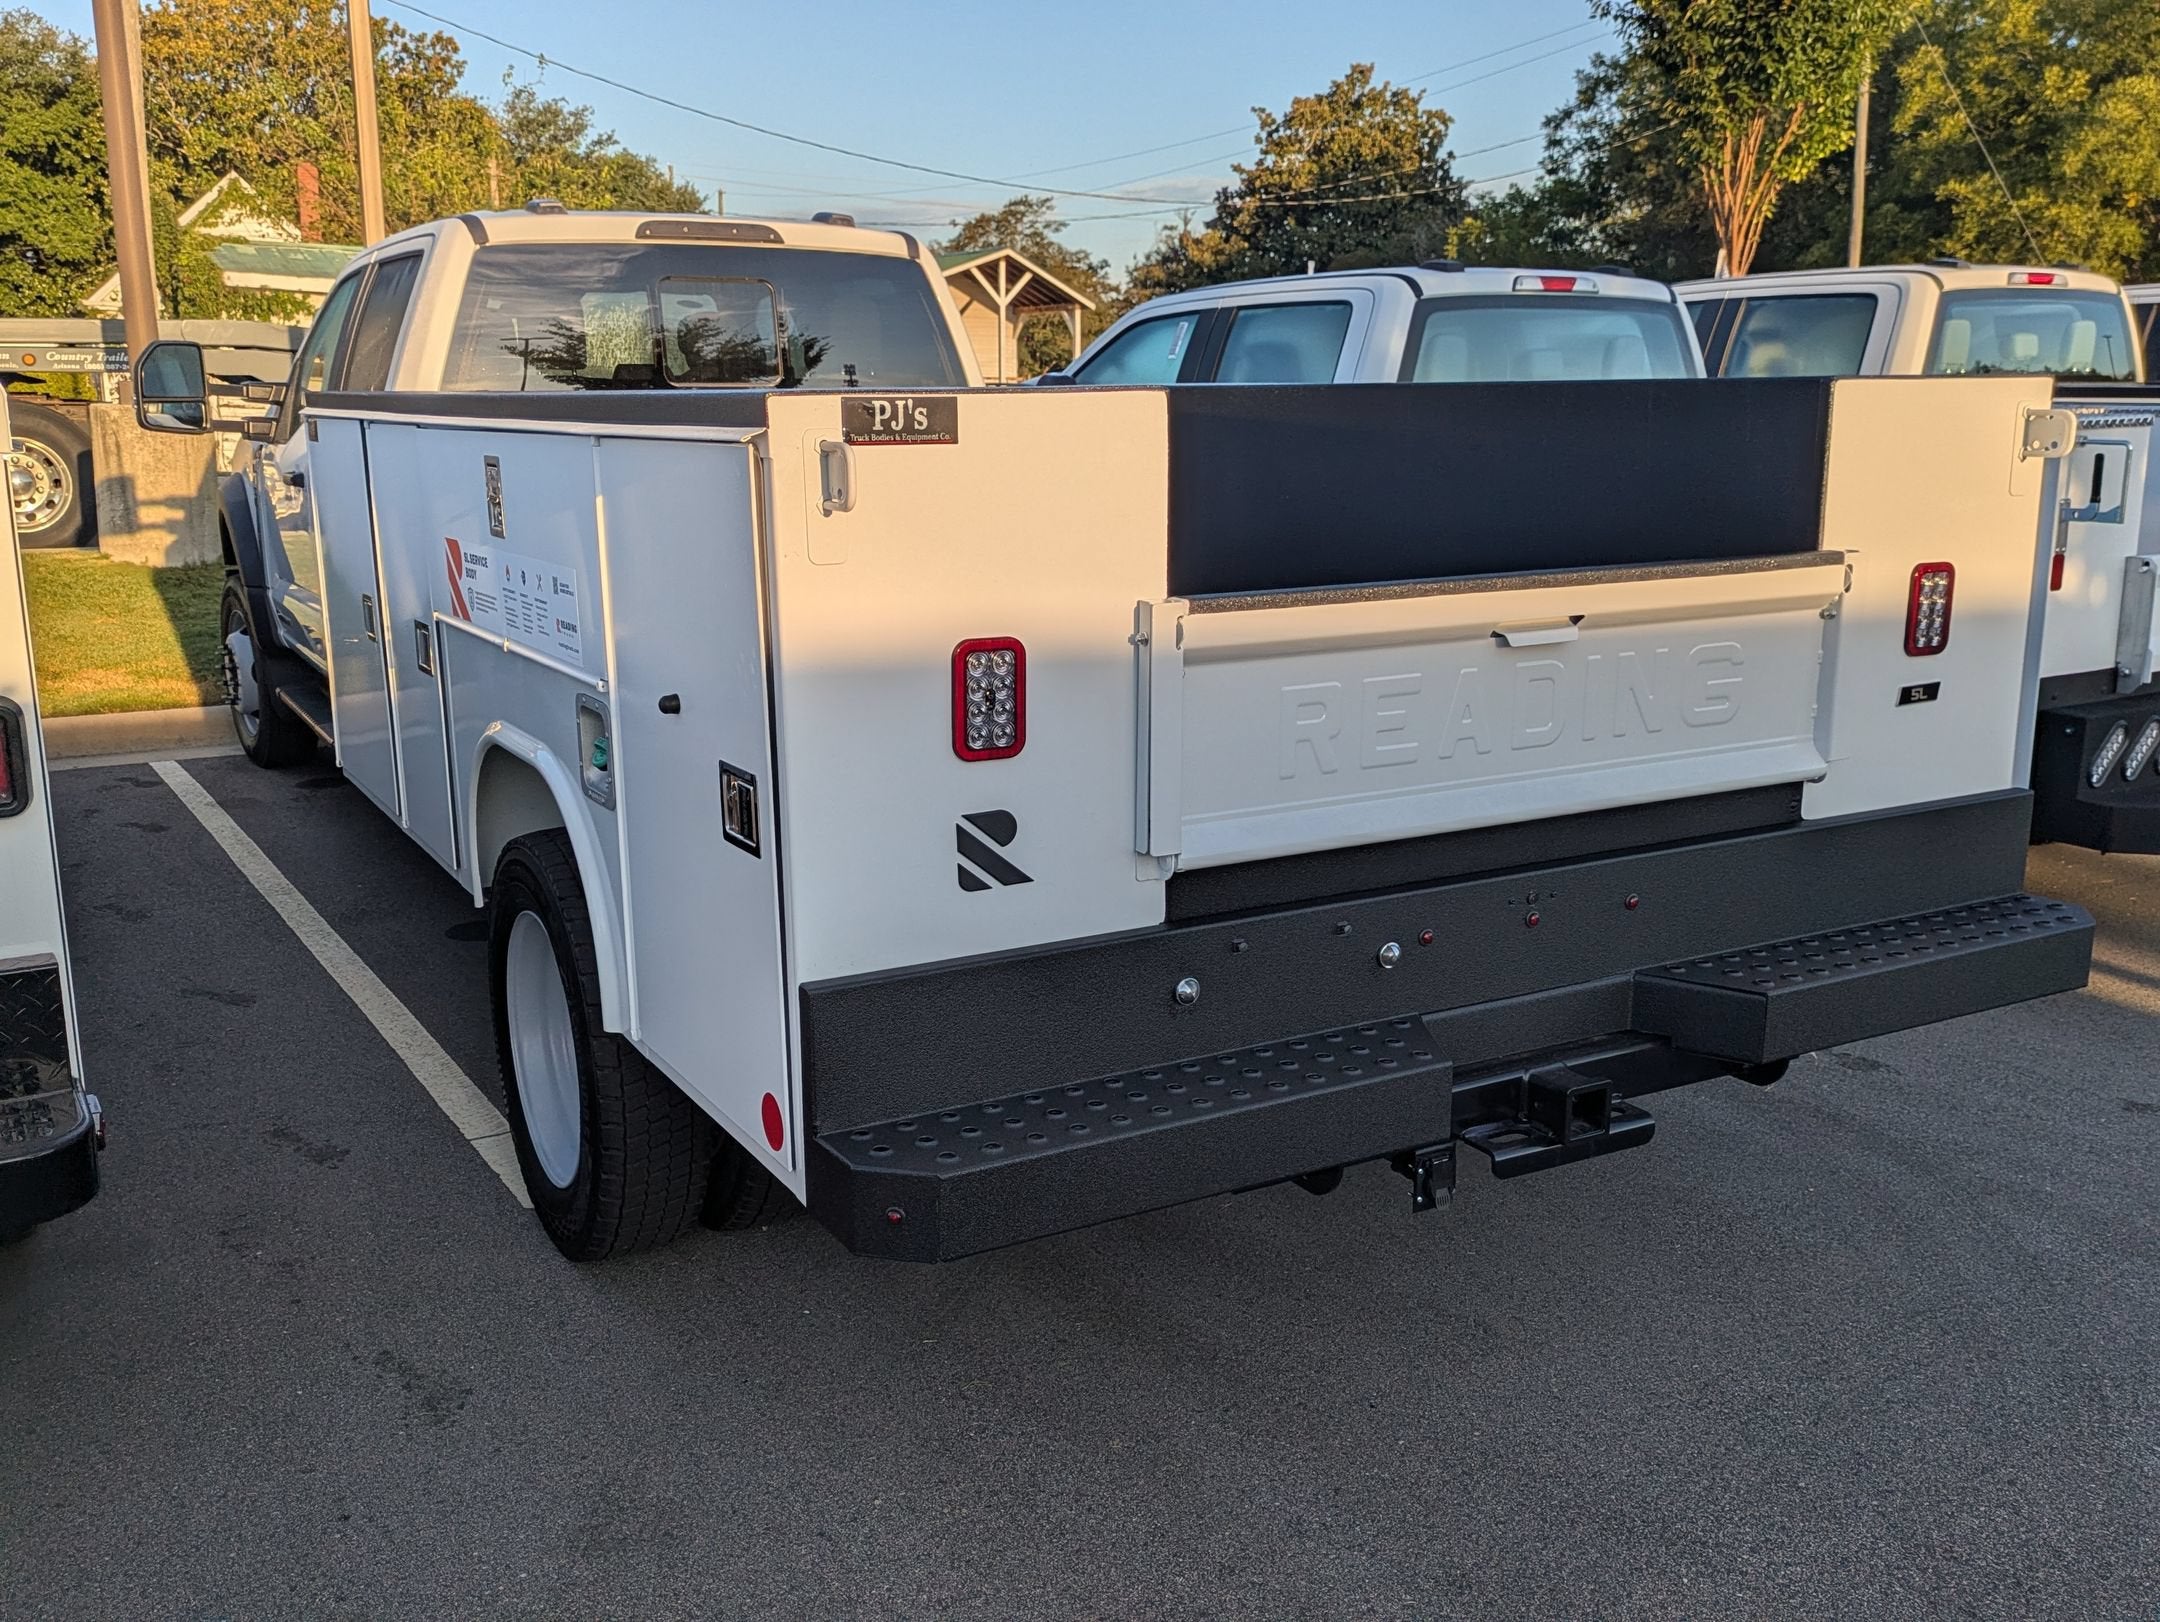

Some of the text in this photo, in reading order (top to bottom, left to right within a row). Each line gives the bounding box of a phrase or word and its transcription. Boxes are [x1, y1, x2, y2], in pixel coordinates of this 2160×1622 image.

[46, 351, 128, 362] Country Traile
[871, 398, 928, 431] PJ's
[850, 433, 870, 441] Truck
[871, 433, 895, 441] Bodies
[902, 432, 939, 443] Equipment
[939, 432, 951, 440] Co.
[469, 553, 488, 568] SERVICE
[465, 567, 477, 580] BODY
[560, 619, 578, 633] READING
[1910, 687, 1928, 701] SL
[1278, 641, 1745, 780] READING
